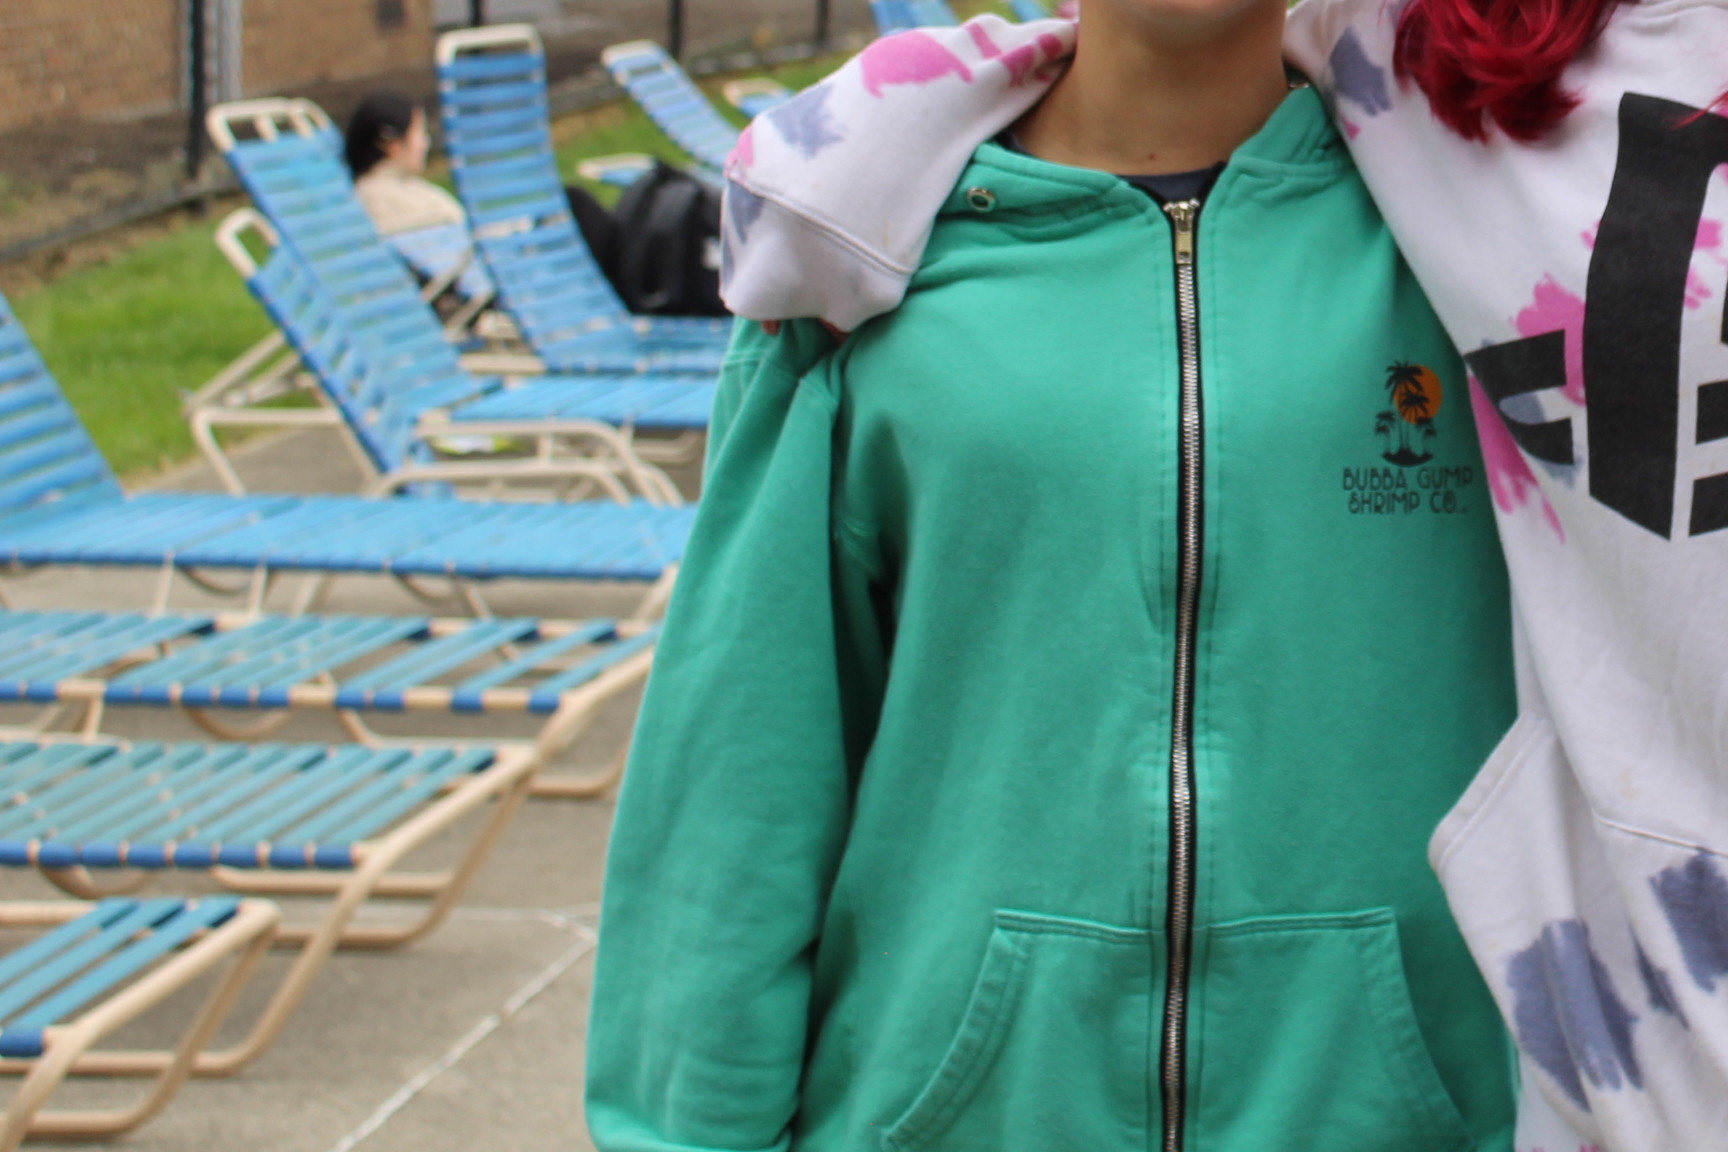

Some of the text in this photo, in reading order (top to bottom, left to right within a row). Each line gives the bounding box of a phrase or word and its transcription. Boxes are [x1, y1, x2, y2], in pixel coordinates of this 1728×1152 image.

[1342, 466, 1474, 491] BUBBA GUMP
[1348, 490, 1421, 515] SHRIMP
